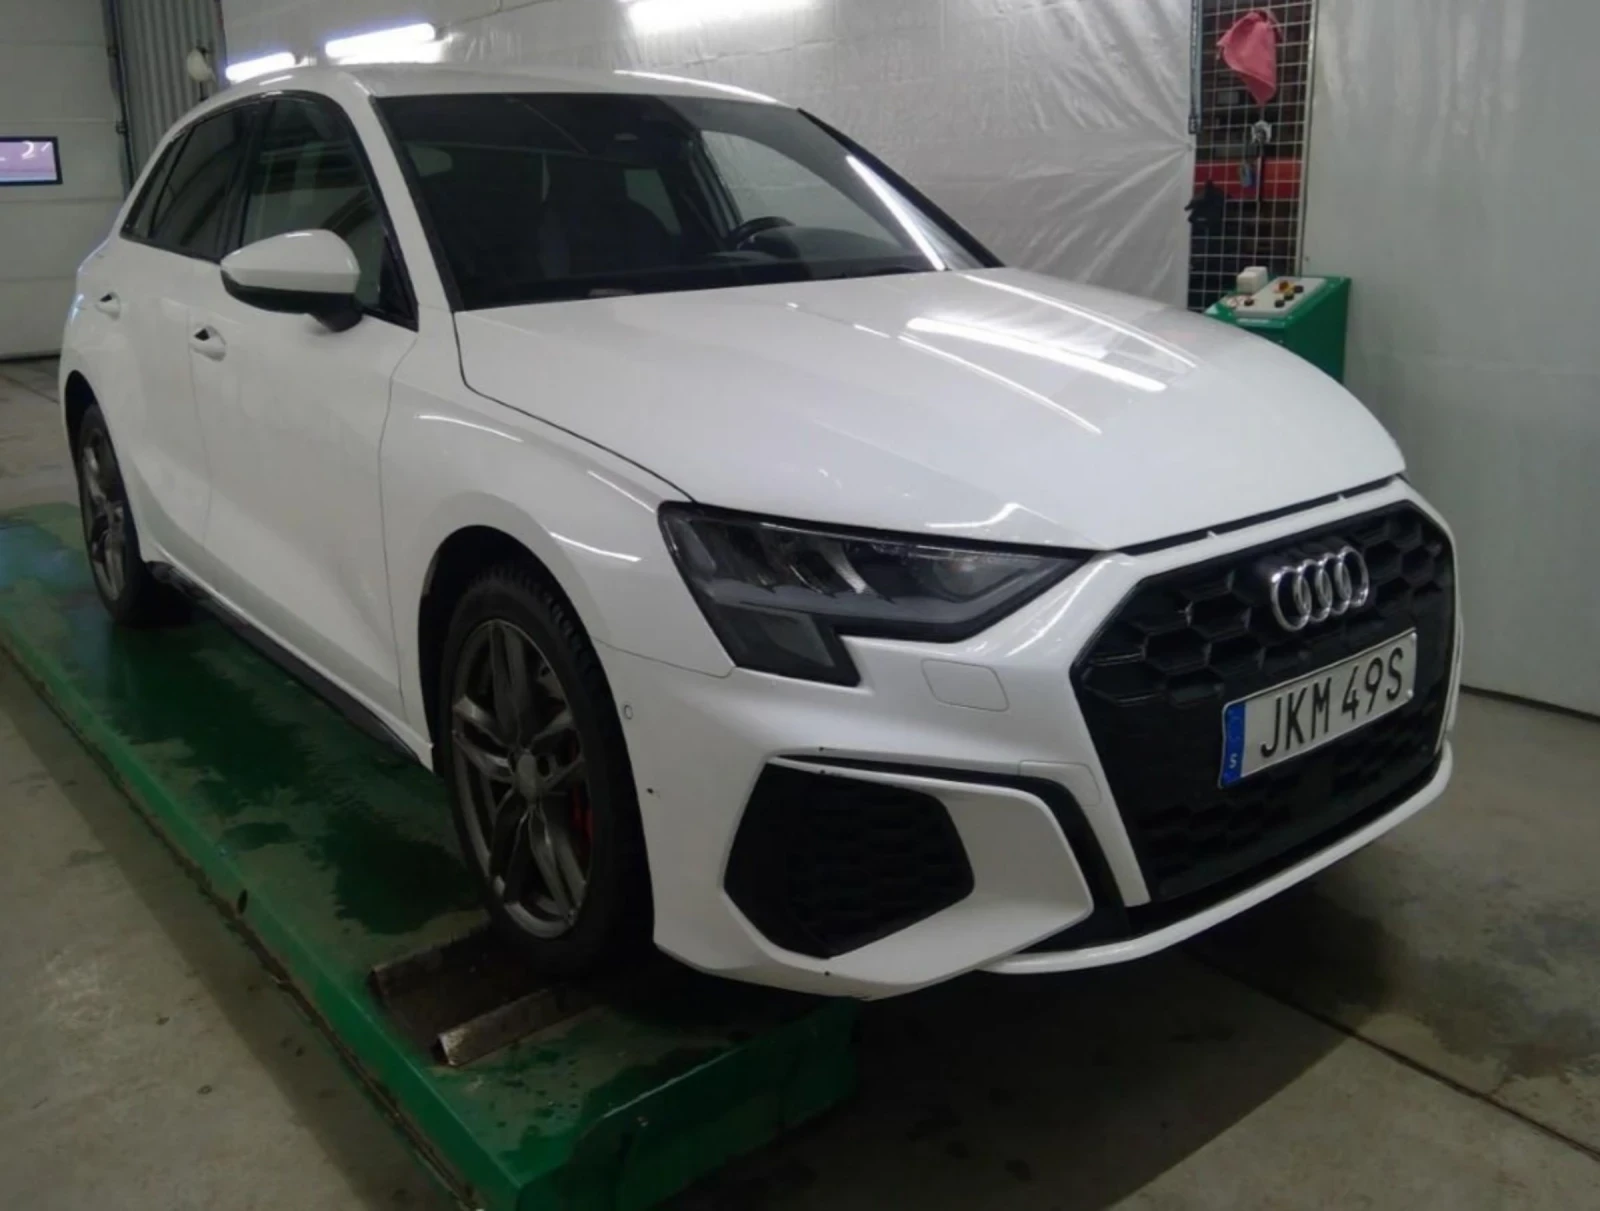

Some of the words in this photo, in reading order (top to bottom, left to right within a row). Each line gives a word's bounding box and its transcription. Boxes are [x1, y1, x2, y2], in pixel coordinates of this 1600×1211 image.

[1260, 677, 1332, 757] JKM
[1341, 647, 1404, 721] 49S
[1229, 753, 1238, 769] S
